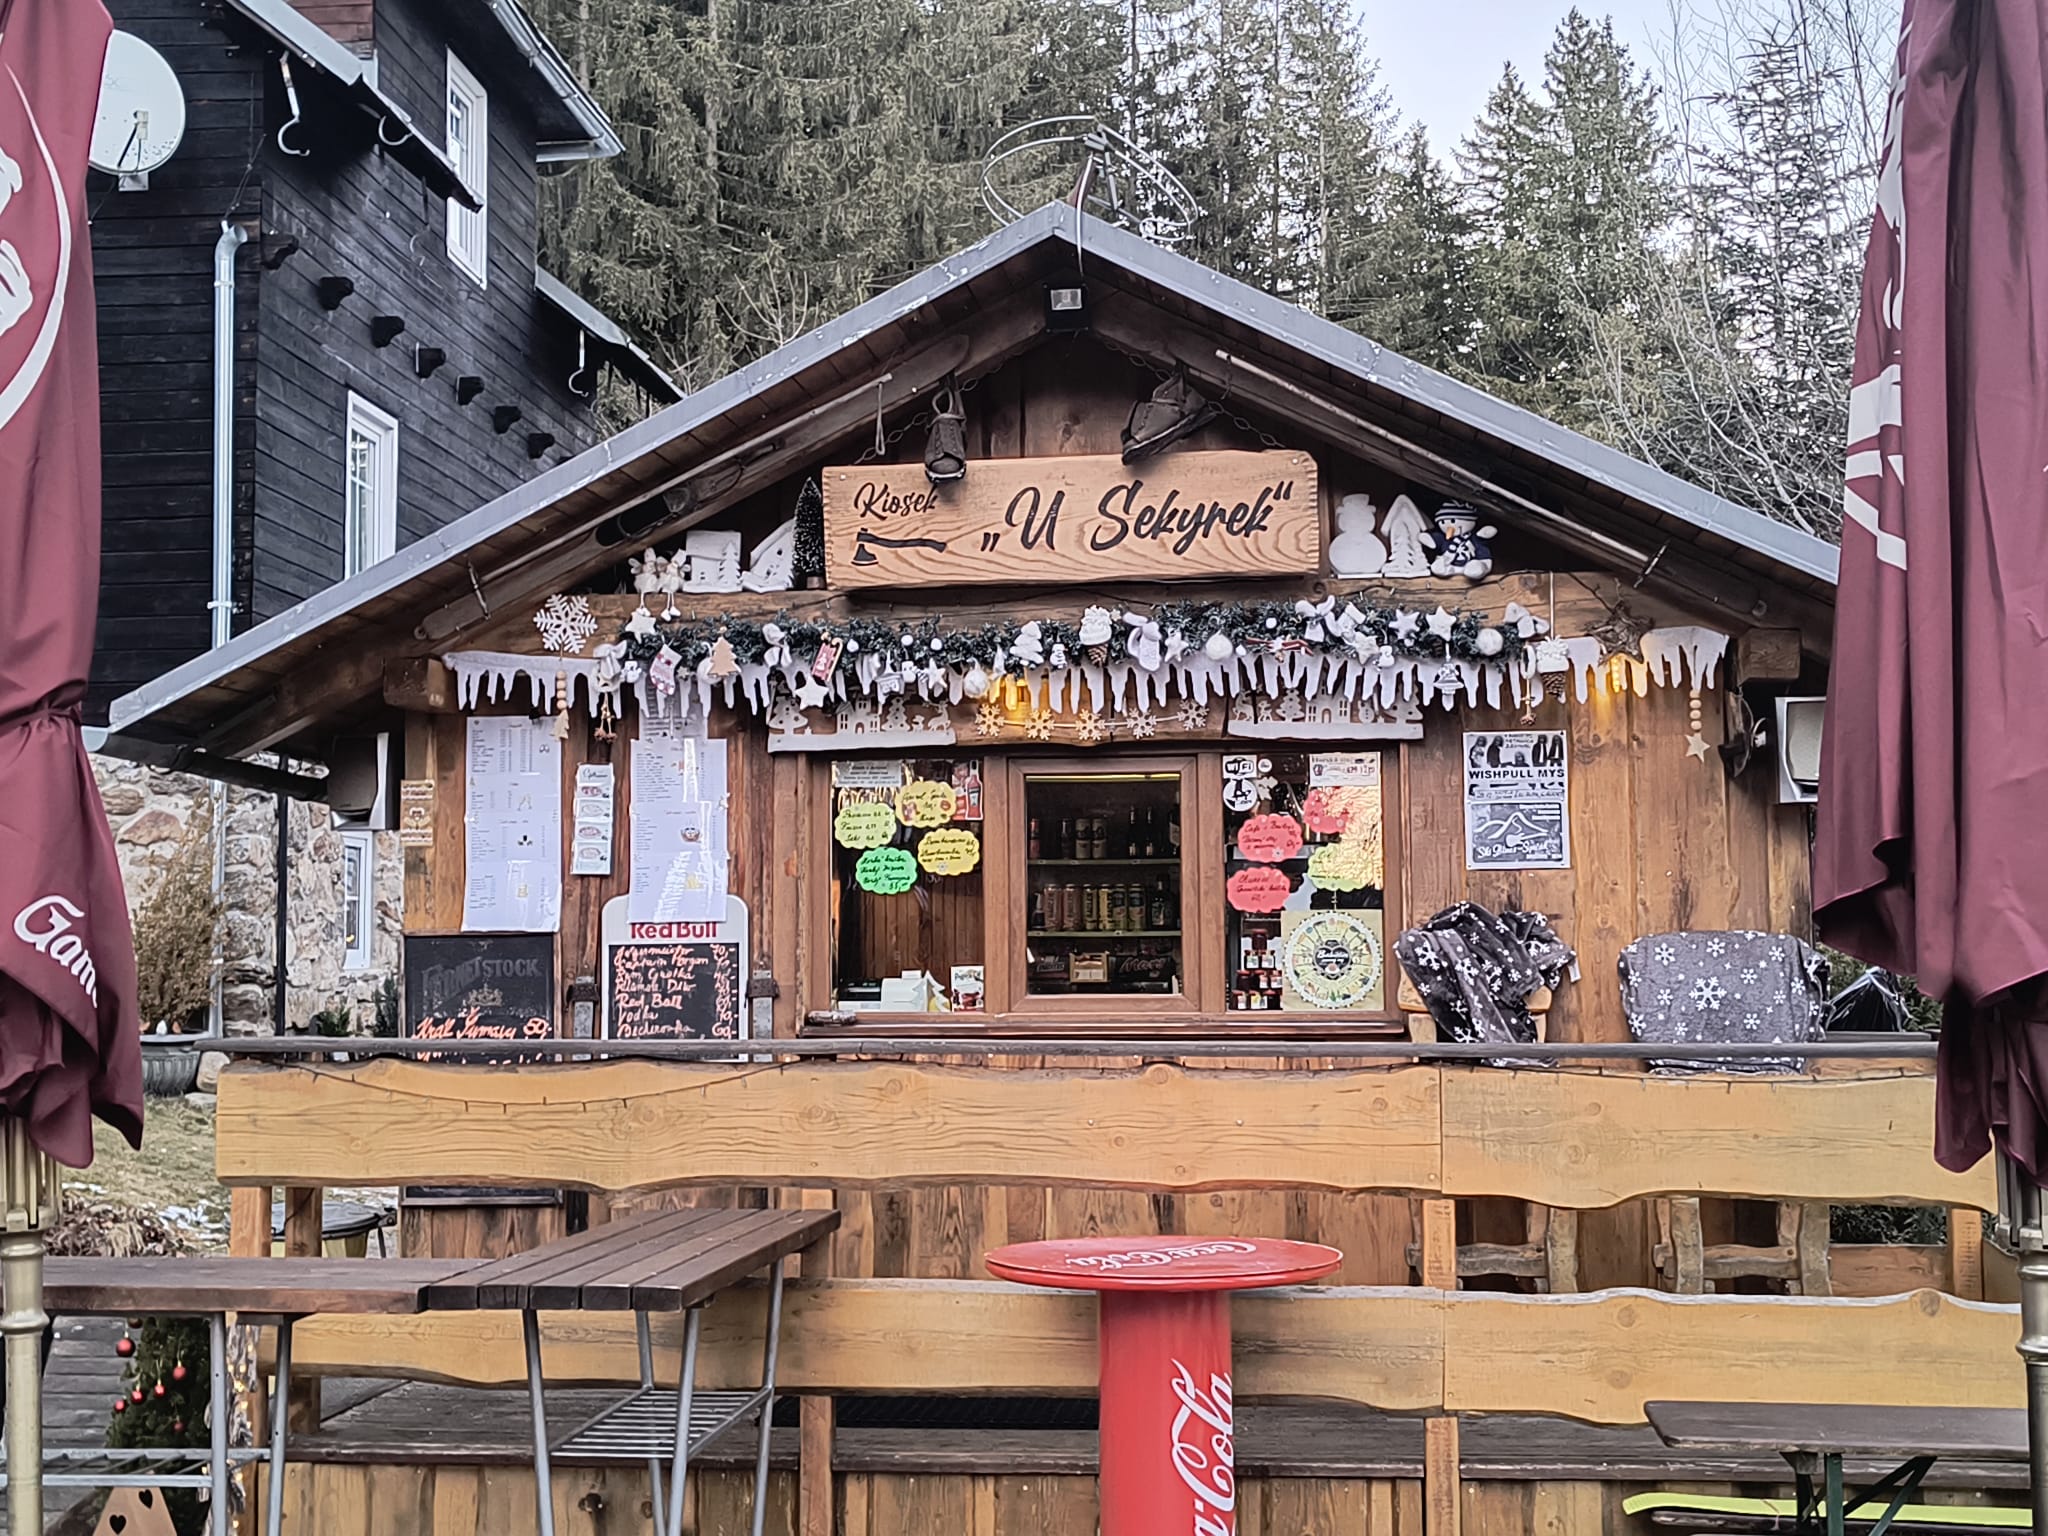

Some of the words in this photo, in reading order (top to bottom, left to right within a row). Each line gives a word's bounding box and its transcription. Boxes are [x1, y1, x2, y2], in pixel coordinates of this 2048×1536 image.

[853, 482, 938, 521] Kiosek
[1468, 769, 1534, 780] WISHPULL
[1537, 768, 1565, 779] MYS
[631, 921, 673, 939] Red
[676, 921, 718, 938] Bull
[481, 959, 542, 978] STOCK
